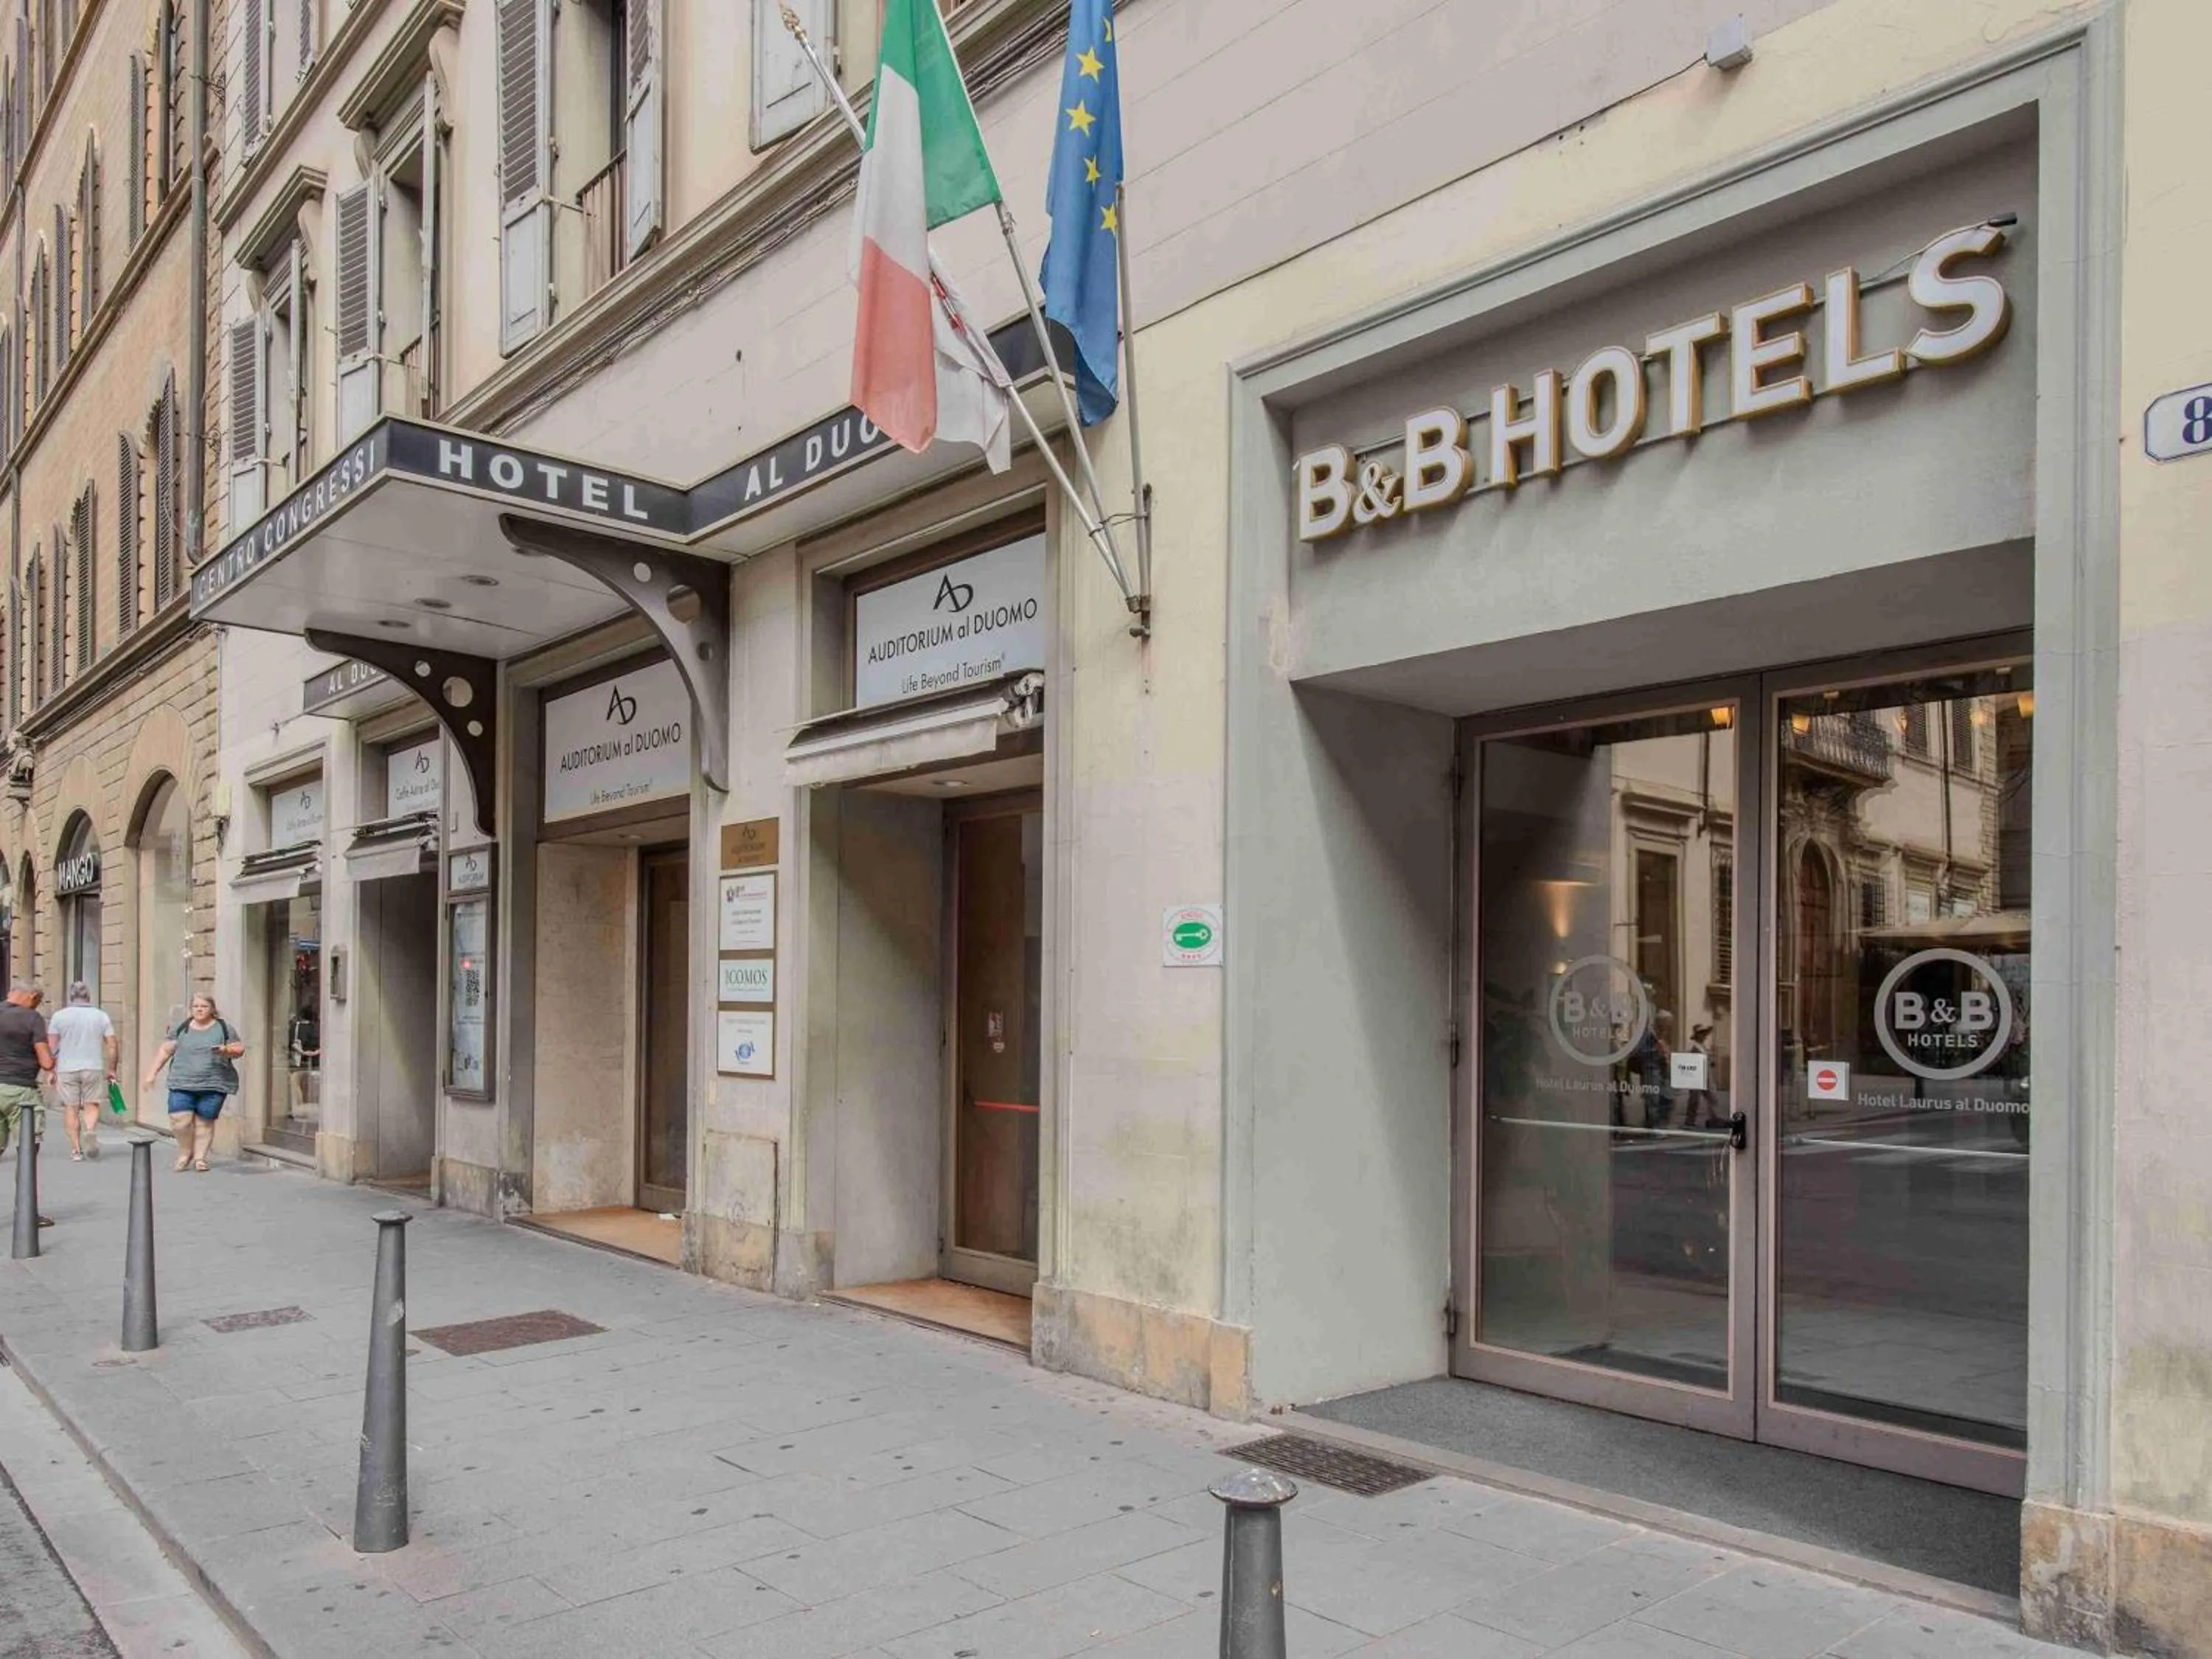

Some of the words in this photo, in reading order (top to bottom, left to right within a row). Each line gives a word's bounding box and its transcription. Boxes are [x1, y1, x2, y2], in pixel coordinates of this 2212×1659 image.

[1298, 405, 1474, 542] B&B
[1490, 224, 2011, 488] HOTELS
[439, 439, 649, 521] HOTEL
[744, 455, 784, 501] AL
[198, 537, 255, 601] CENTRO
[263, 439, 375, 552] CONGRESSI
[868, 622, 953, 665] AUDITORIUM
[956, 616, 970, 639] al
[973, 597, 1038, 635] DUOMO
[328, 670, 344, 695] AL
[902, 674, 918, 694] Life
[921, 664, 959, 689] Beyond
[560, 739, 622, 773] AUDITORIUM
[624, 734, 633, 756] al
[636, 721, 681, 753] DUOMO
[58, 852, 94, 889] MANGO
[726, 968, 768, 985] ICOMOS
[1564, 991, 1634, 1023] B&B
[1894, 992, 1994, 1030] B&B
[1907, 1034, 1978, 1048] HOTELS
[1607, 1081, 1618, 1093] al
[1619, 1081, 1660, 1094] Duomo
[1857, 1092, 1896, 1107] Hotel
[1899, 1094, 1952, 1110] Laurus
[1955, 1097, 1970, 1110] al
[1973, 1098, 2030, 1114] Duomo
